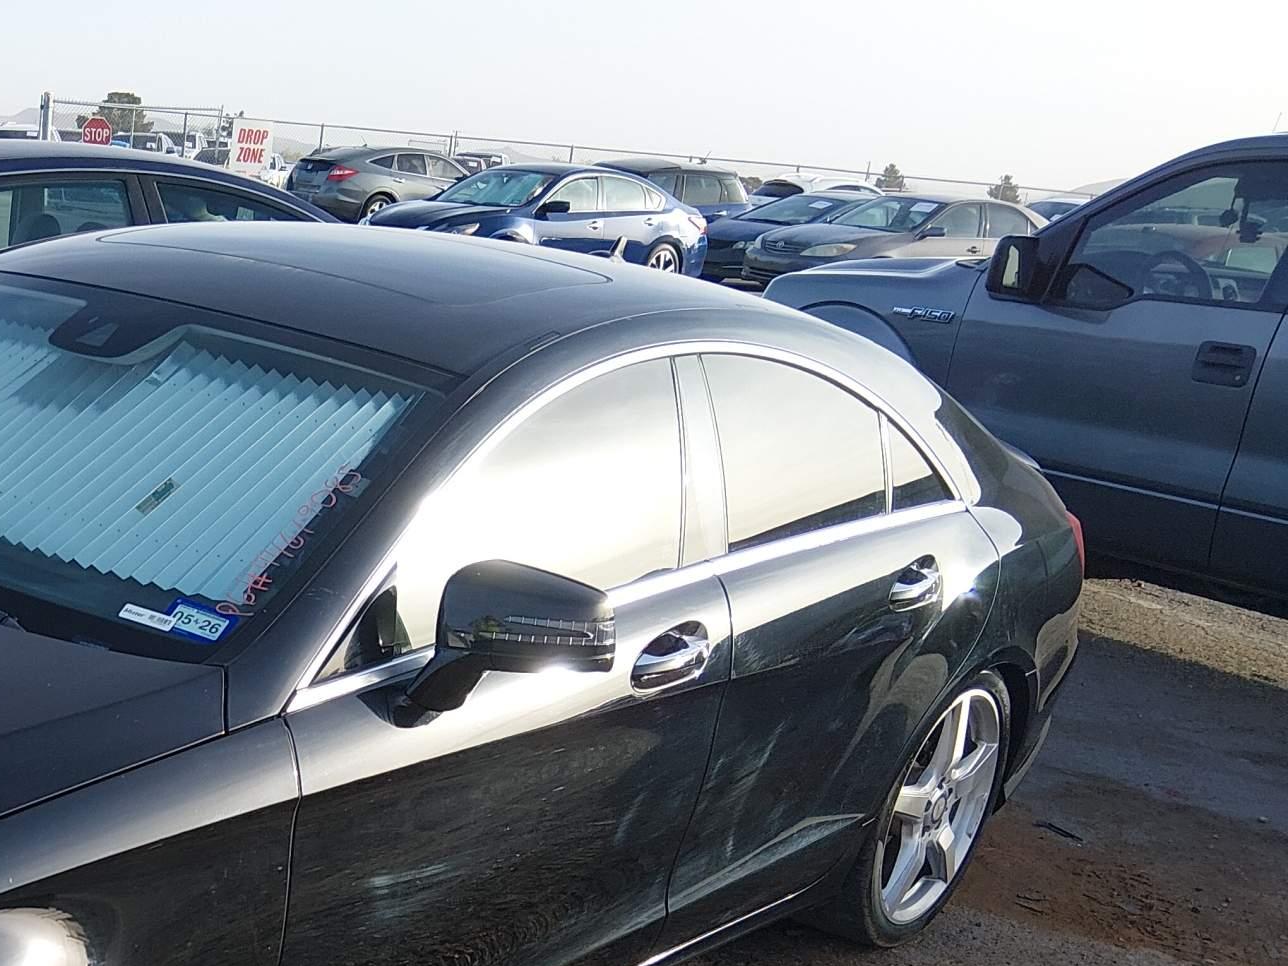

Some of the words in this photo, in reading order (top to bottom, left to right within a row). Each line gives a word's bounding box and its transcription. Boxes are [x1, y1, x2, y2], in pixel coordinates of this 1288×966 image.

[84, 127, 110, 143] STOP
[237, 128, 269, 145] DROP
[236, 146, 266, 164] ZONE
[198, 619, 222, 635] 26
